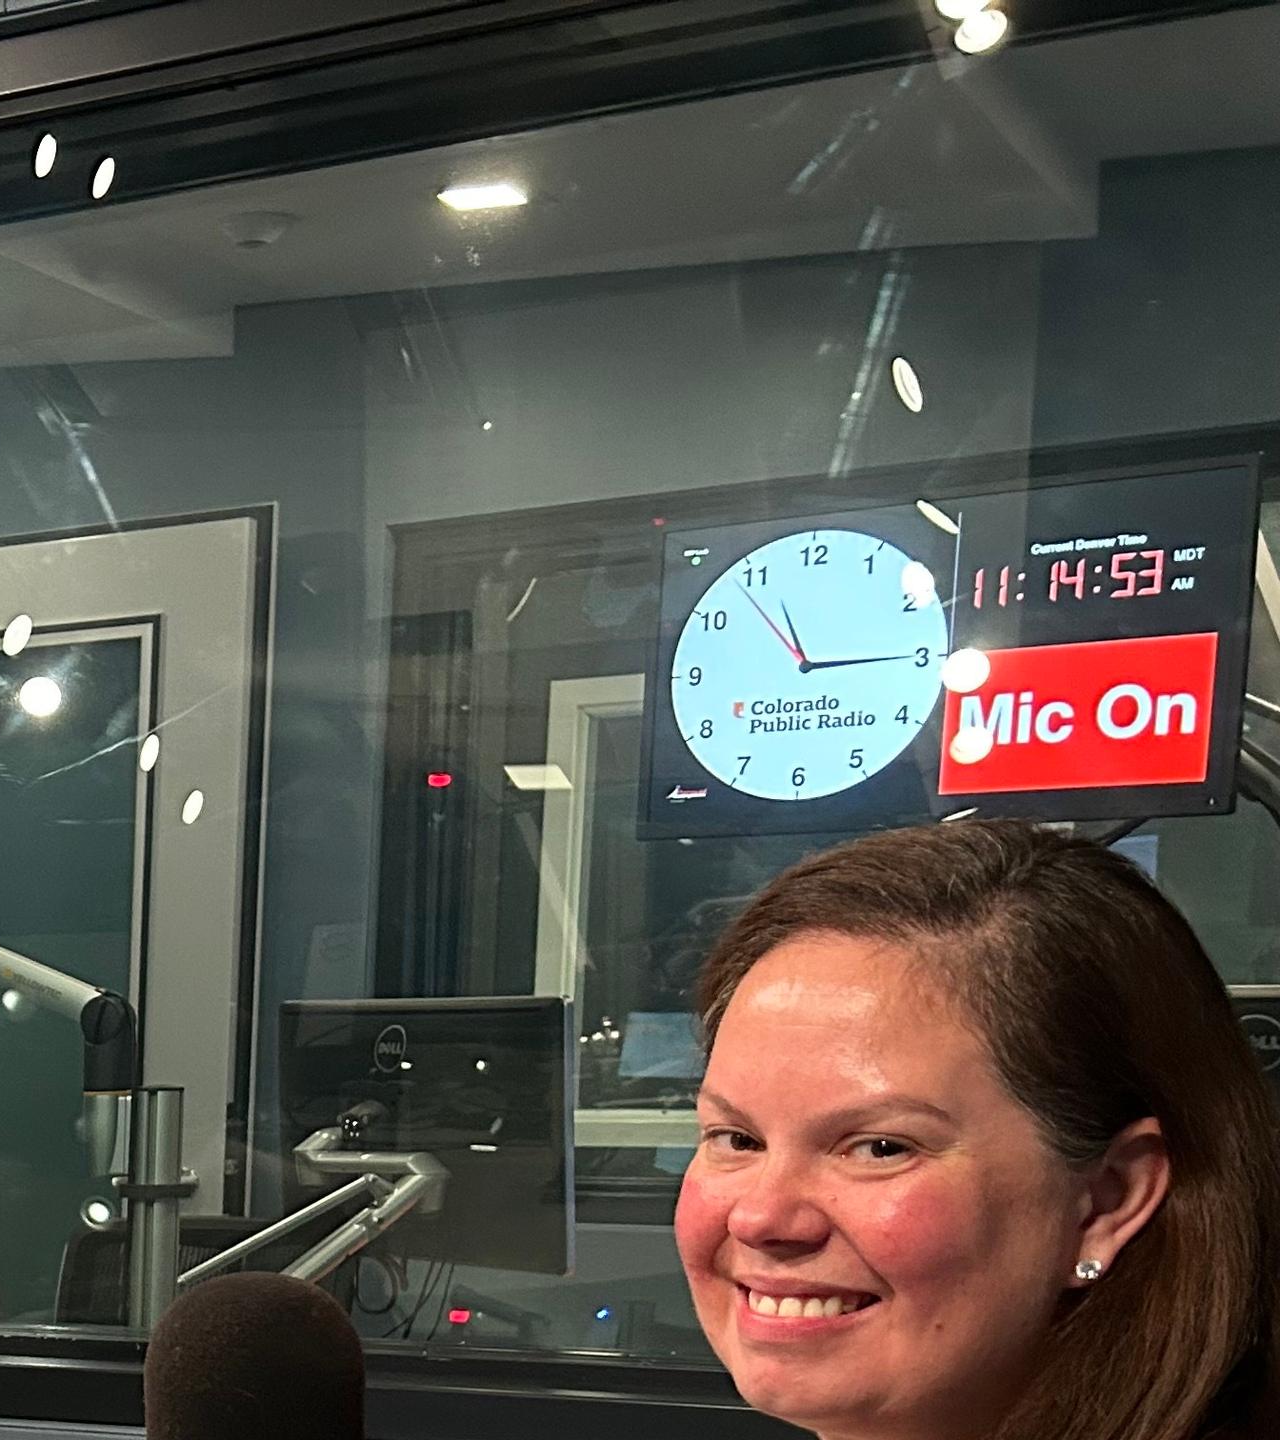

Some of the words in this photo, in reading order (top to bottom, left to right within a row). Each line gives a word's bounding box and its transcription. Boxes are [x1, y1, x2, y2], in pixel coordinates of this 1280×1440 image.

[1117, 534, 1148, 546] Time
[800, 545, 829, 566] 12
[863, 554, 874, 575] 1
[1173, 546, 1206, 562] MDT
[743, 566, 768, 587] 11
[1170, 576, 1195, 591] AM
[701, 610, 727, 632] 10
[914, 647, 929, 668] 3
[689, 667, 702, 686] 9
[751, 695, 839, 716] Colorado
[894, 705, 909, 725] 4
[958, 691, 1075, 746] Mic
[1096, 683, 1197, 740] On
[700, 719, 713, 739] 8
[749, 714, 811, 734] Public
[817, 711, 876, 729] Radio
[737, 756, 751, 775] 7
[849, 748, 864, 769] 5
[792, 767, 805, 787] 6
